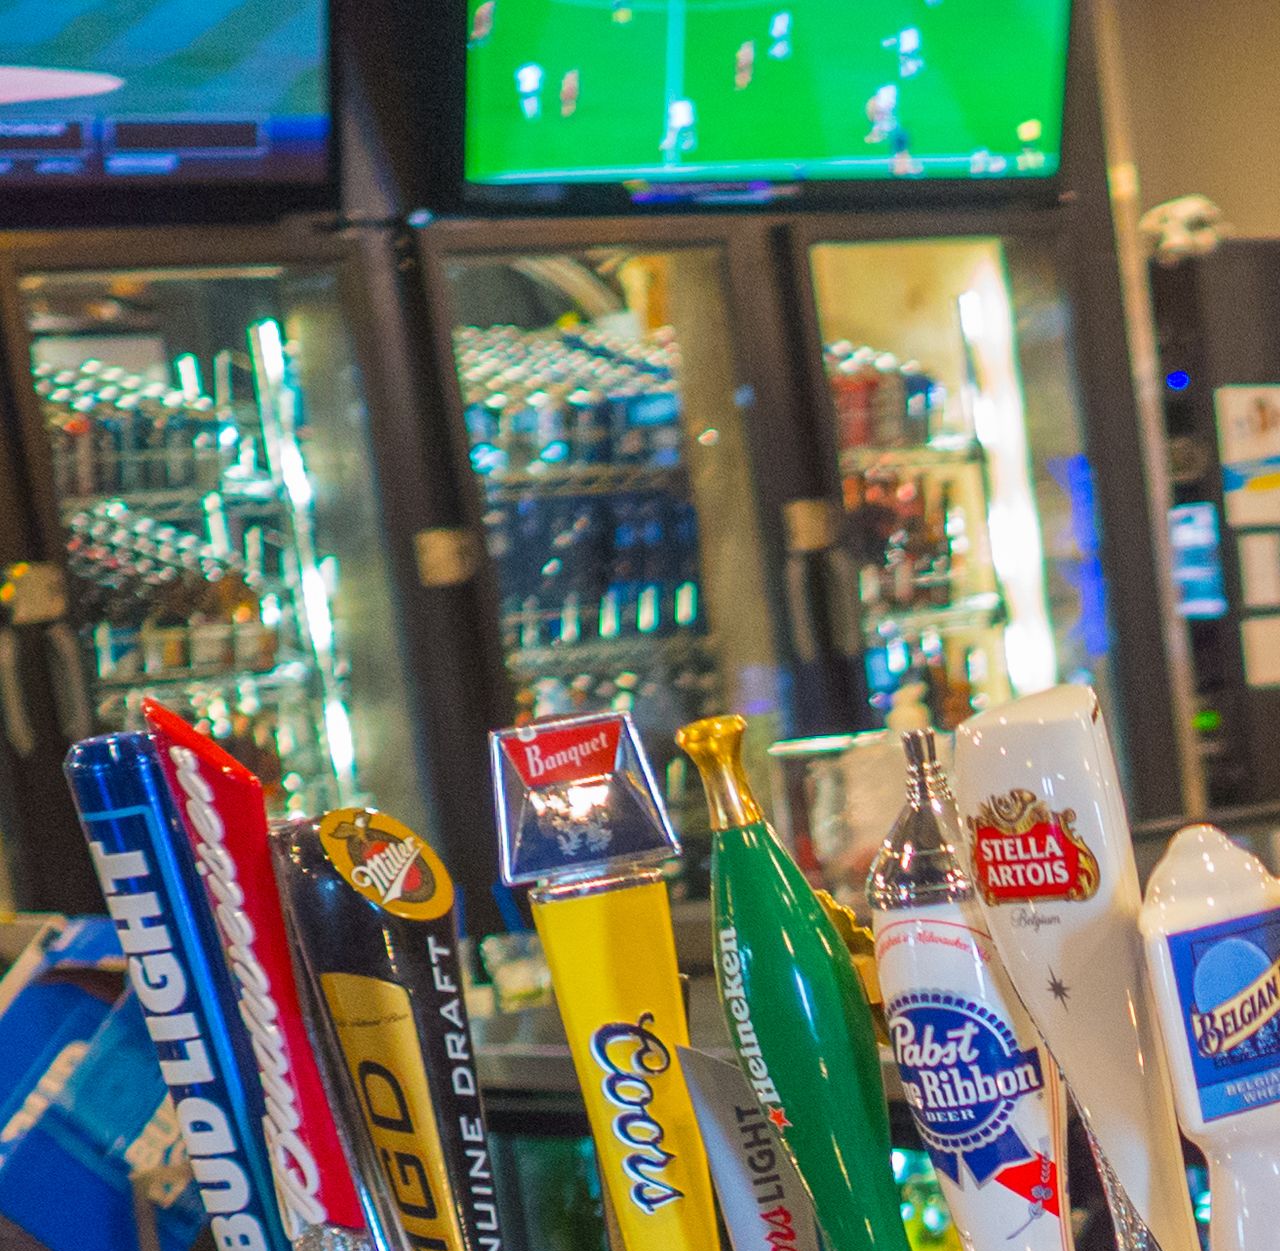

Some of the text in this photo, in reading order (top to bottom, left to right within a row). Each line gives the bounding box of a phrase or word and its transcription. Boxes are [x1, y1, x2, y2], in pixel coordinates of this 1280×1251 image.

[523, 731, 610, 779] Banquet
[351, 836, 421, 904] Miller
[980, 833, 1065, 863] STELLA
[986, 860, 1070, 888] ARTOIS
[1010, 907, 1062, 932] Belgium
[88, 840, 215, 1088] LIGHT
[169, 745, 327, 1240] Budweiser
[426, 935, 477, 1097] DRAFT
[718, 926, 782, 1105] Heineken
[888, 1015, 980, 1068] Pabst
[1197, 975, 1280, 1058] BELGIAN
[589, 1011, 686, 1216] Coors
[919, 1061, 1041, 1110] Ribbon
[926, 1108, 977, 1123] BEER
[735, 1105, 786, 1205] LIGHT
